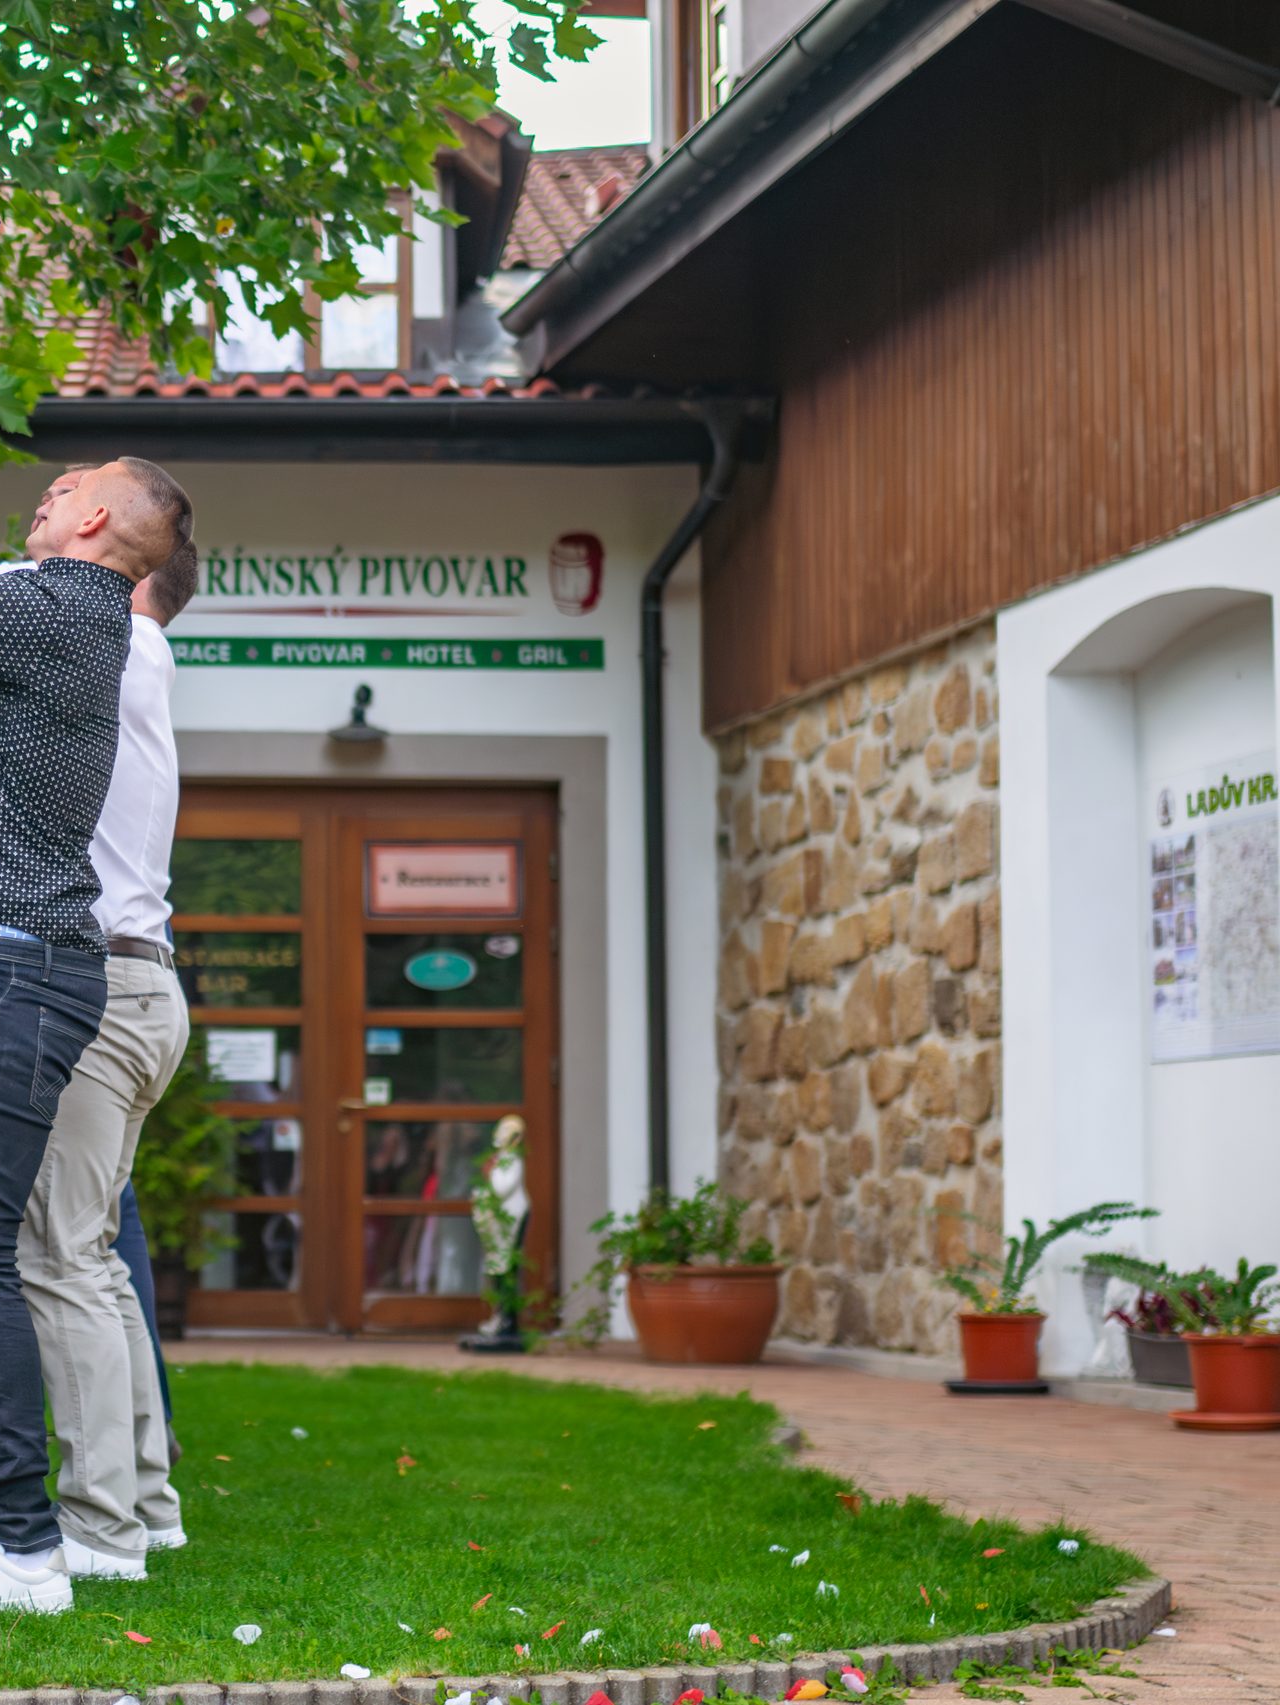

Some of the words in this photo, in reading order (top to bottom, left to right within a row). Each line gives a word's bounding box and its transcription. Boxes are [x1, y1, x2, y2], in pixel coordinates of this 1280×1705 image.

[195, 545, 349, 596] ŘÍNSKÝ
[359, 555, 529, 597] PIVOVAR
[272, 643, 366, 663] PIVOVAR
[407, 644, 476, 665] HOTEL
[518, 645, 567, 666] GRIL
[1186, 774, 1245, 817] LADŮV
